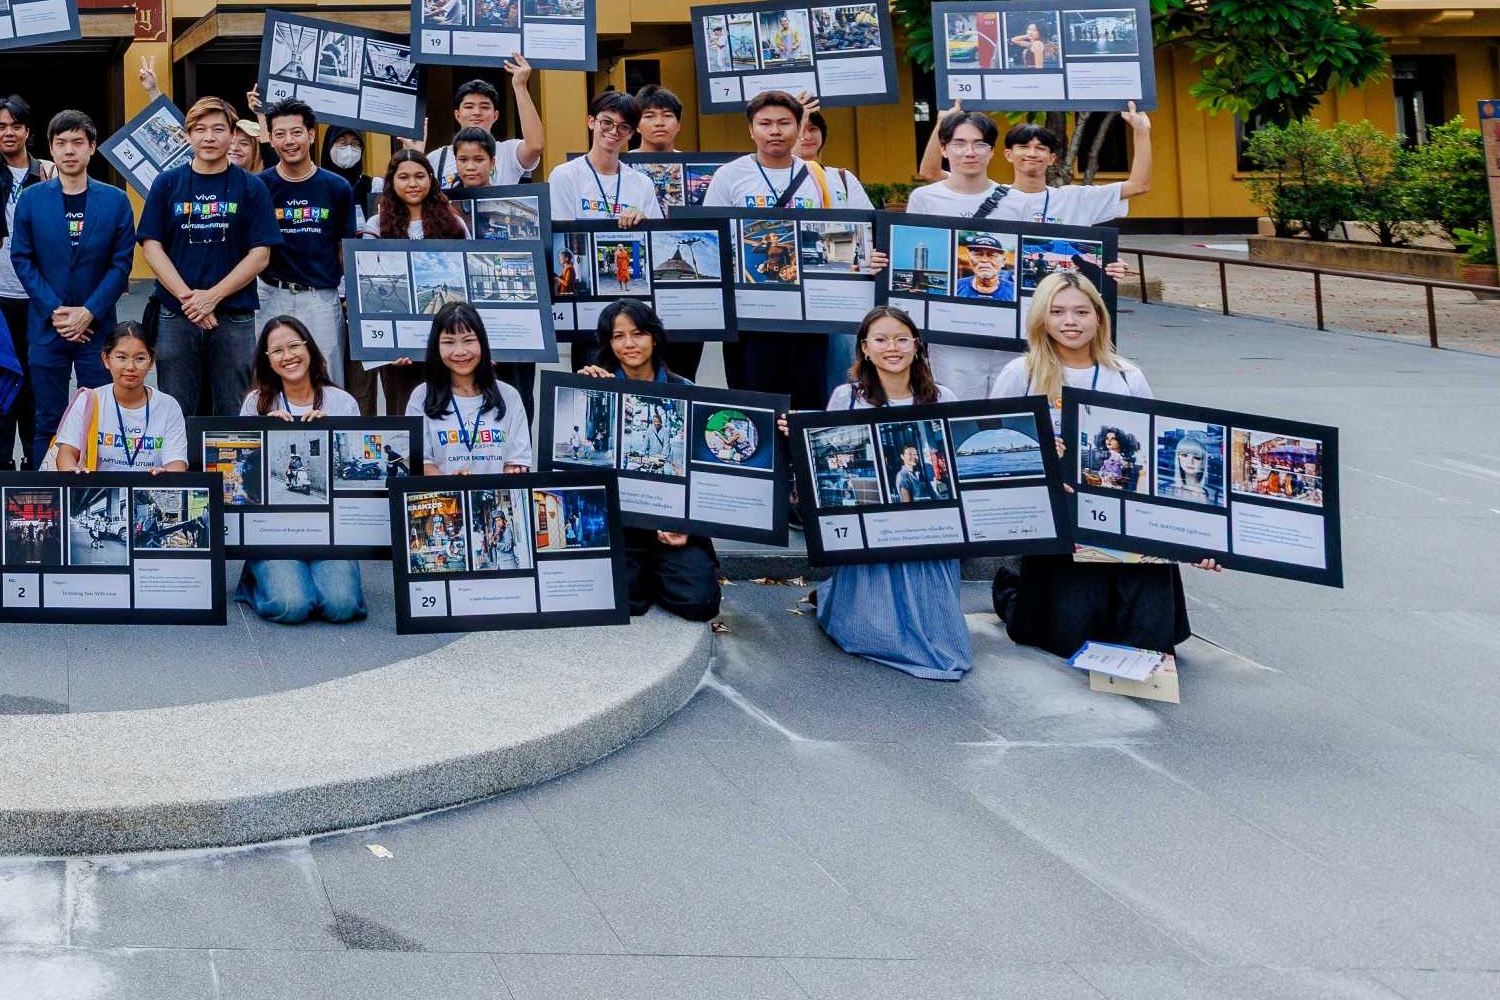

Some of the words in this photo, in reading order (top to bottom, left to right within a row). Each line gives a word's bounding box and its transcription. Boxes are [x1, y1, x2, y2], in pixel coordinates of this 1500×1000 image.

[195, 193, 217, 201] vivo
[175, 202, 238, 216] ACADEMY
[275, 207, 330, 220] CADEMY
[1091, 509, 1107, 522] 16
[834, 527, 848, 539] 17
[17, 587, 26, 598] 2
[421, 596, 437, 608] 29
